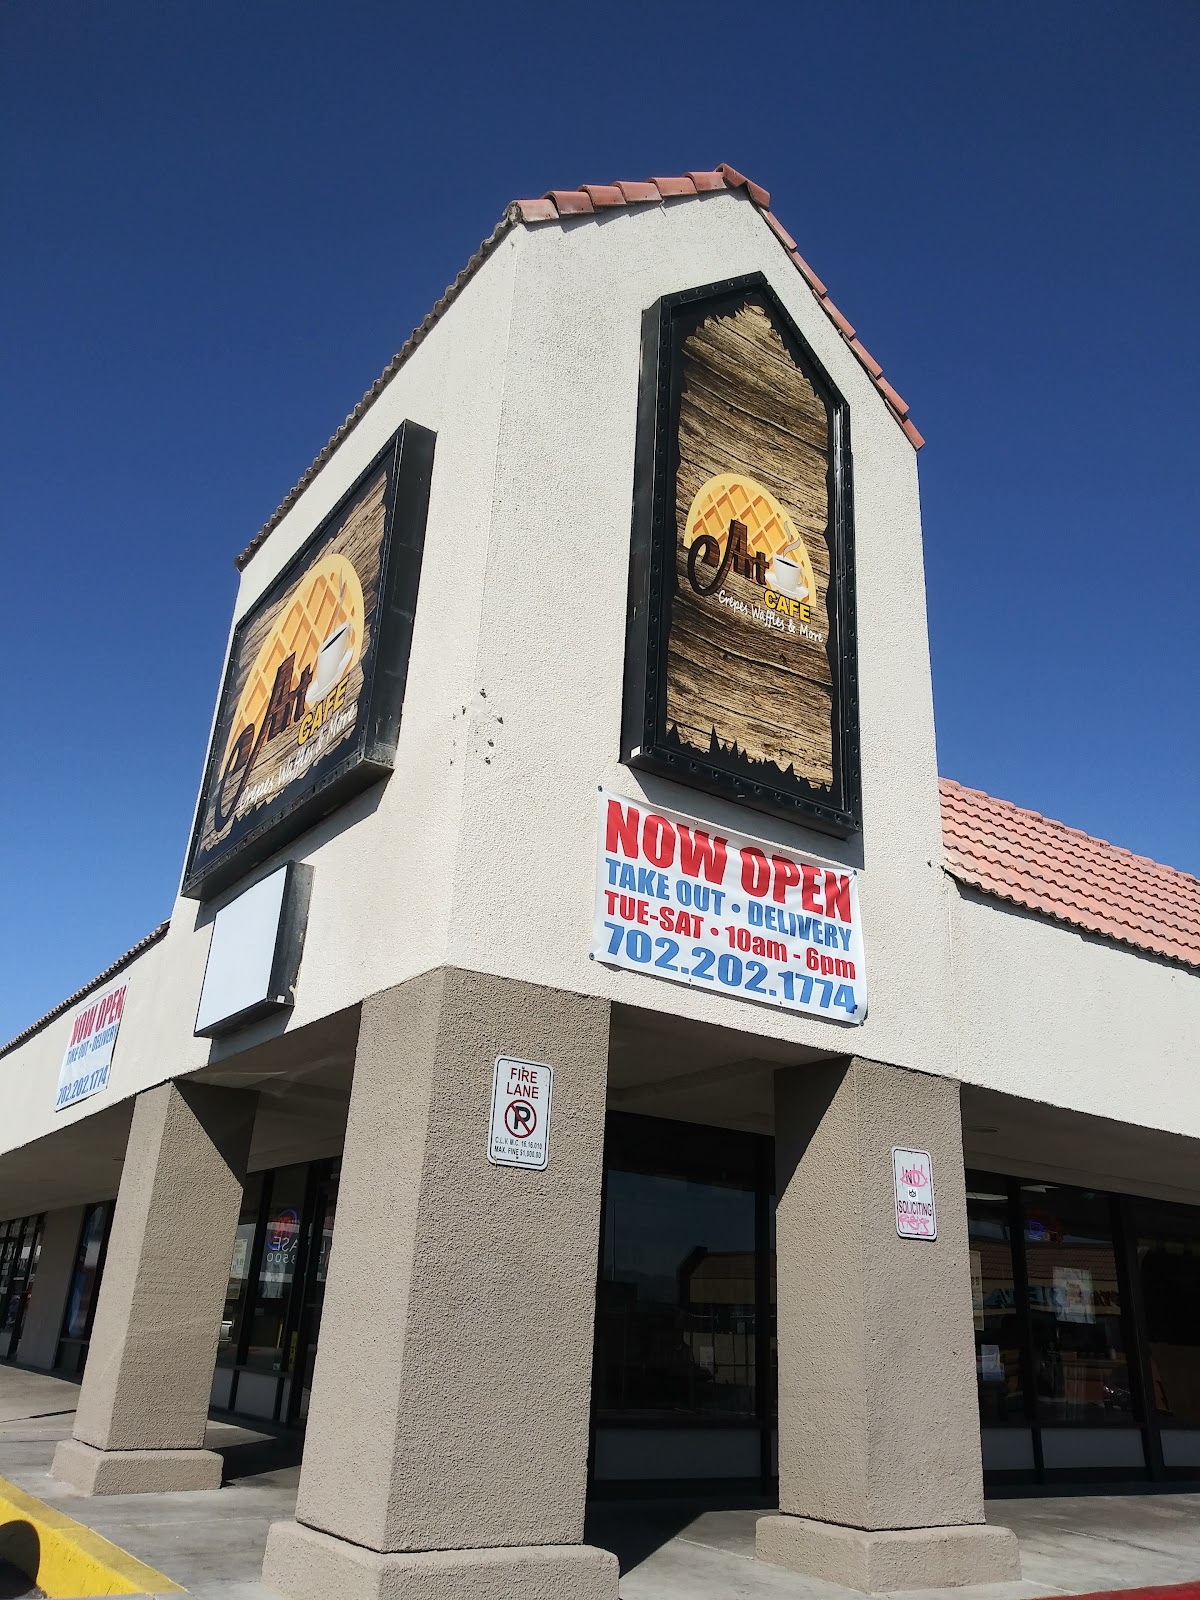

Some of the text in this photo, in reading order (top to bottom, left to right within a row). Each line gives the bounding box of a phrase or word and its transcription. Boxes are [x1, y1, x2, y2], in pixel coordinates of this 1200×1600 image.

[718, 589, 824, 643] Crepes Waffles & More
[764, 589, 811, 623] CAFE
[298, 675, 349, 746] CAFE
[605, 799, 852, 924] NOW OPEN
[605, 858, 852, 951] TAKE OUT DELIVERY
[604, 890, 704, 939] TUE-SAT
[725, 925, 788, 962] 10am
[806, 947, 856, 980] 6pm
[604, 921, 858, 1014] 702.202.1774
[70, 985, 127, 1048] NOW OPEN
[506, 1081, 539, 1099] LANE
[510, 1067, 538, 1084] FIRE
[507, 1147, 519, 1156] FINE
[905, 1168, 920, 1185] NO
[898, 1200, 932, 1216] SOLICITING
